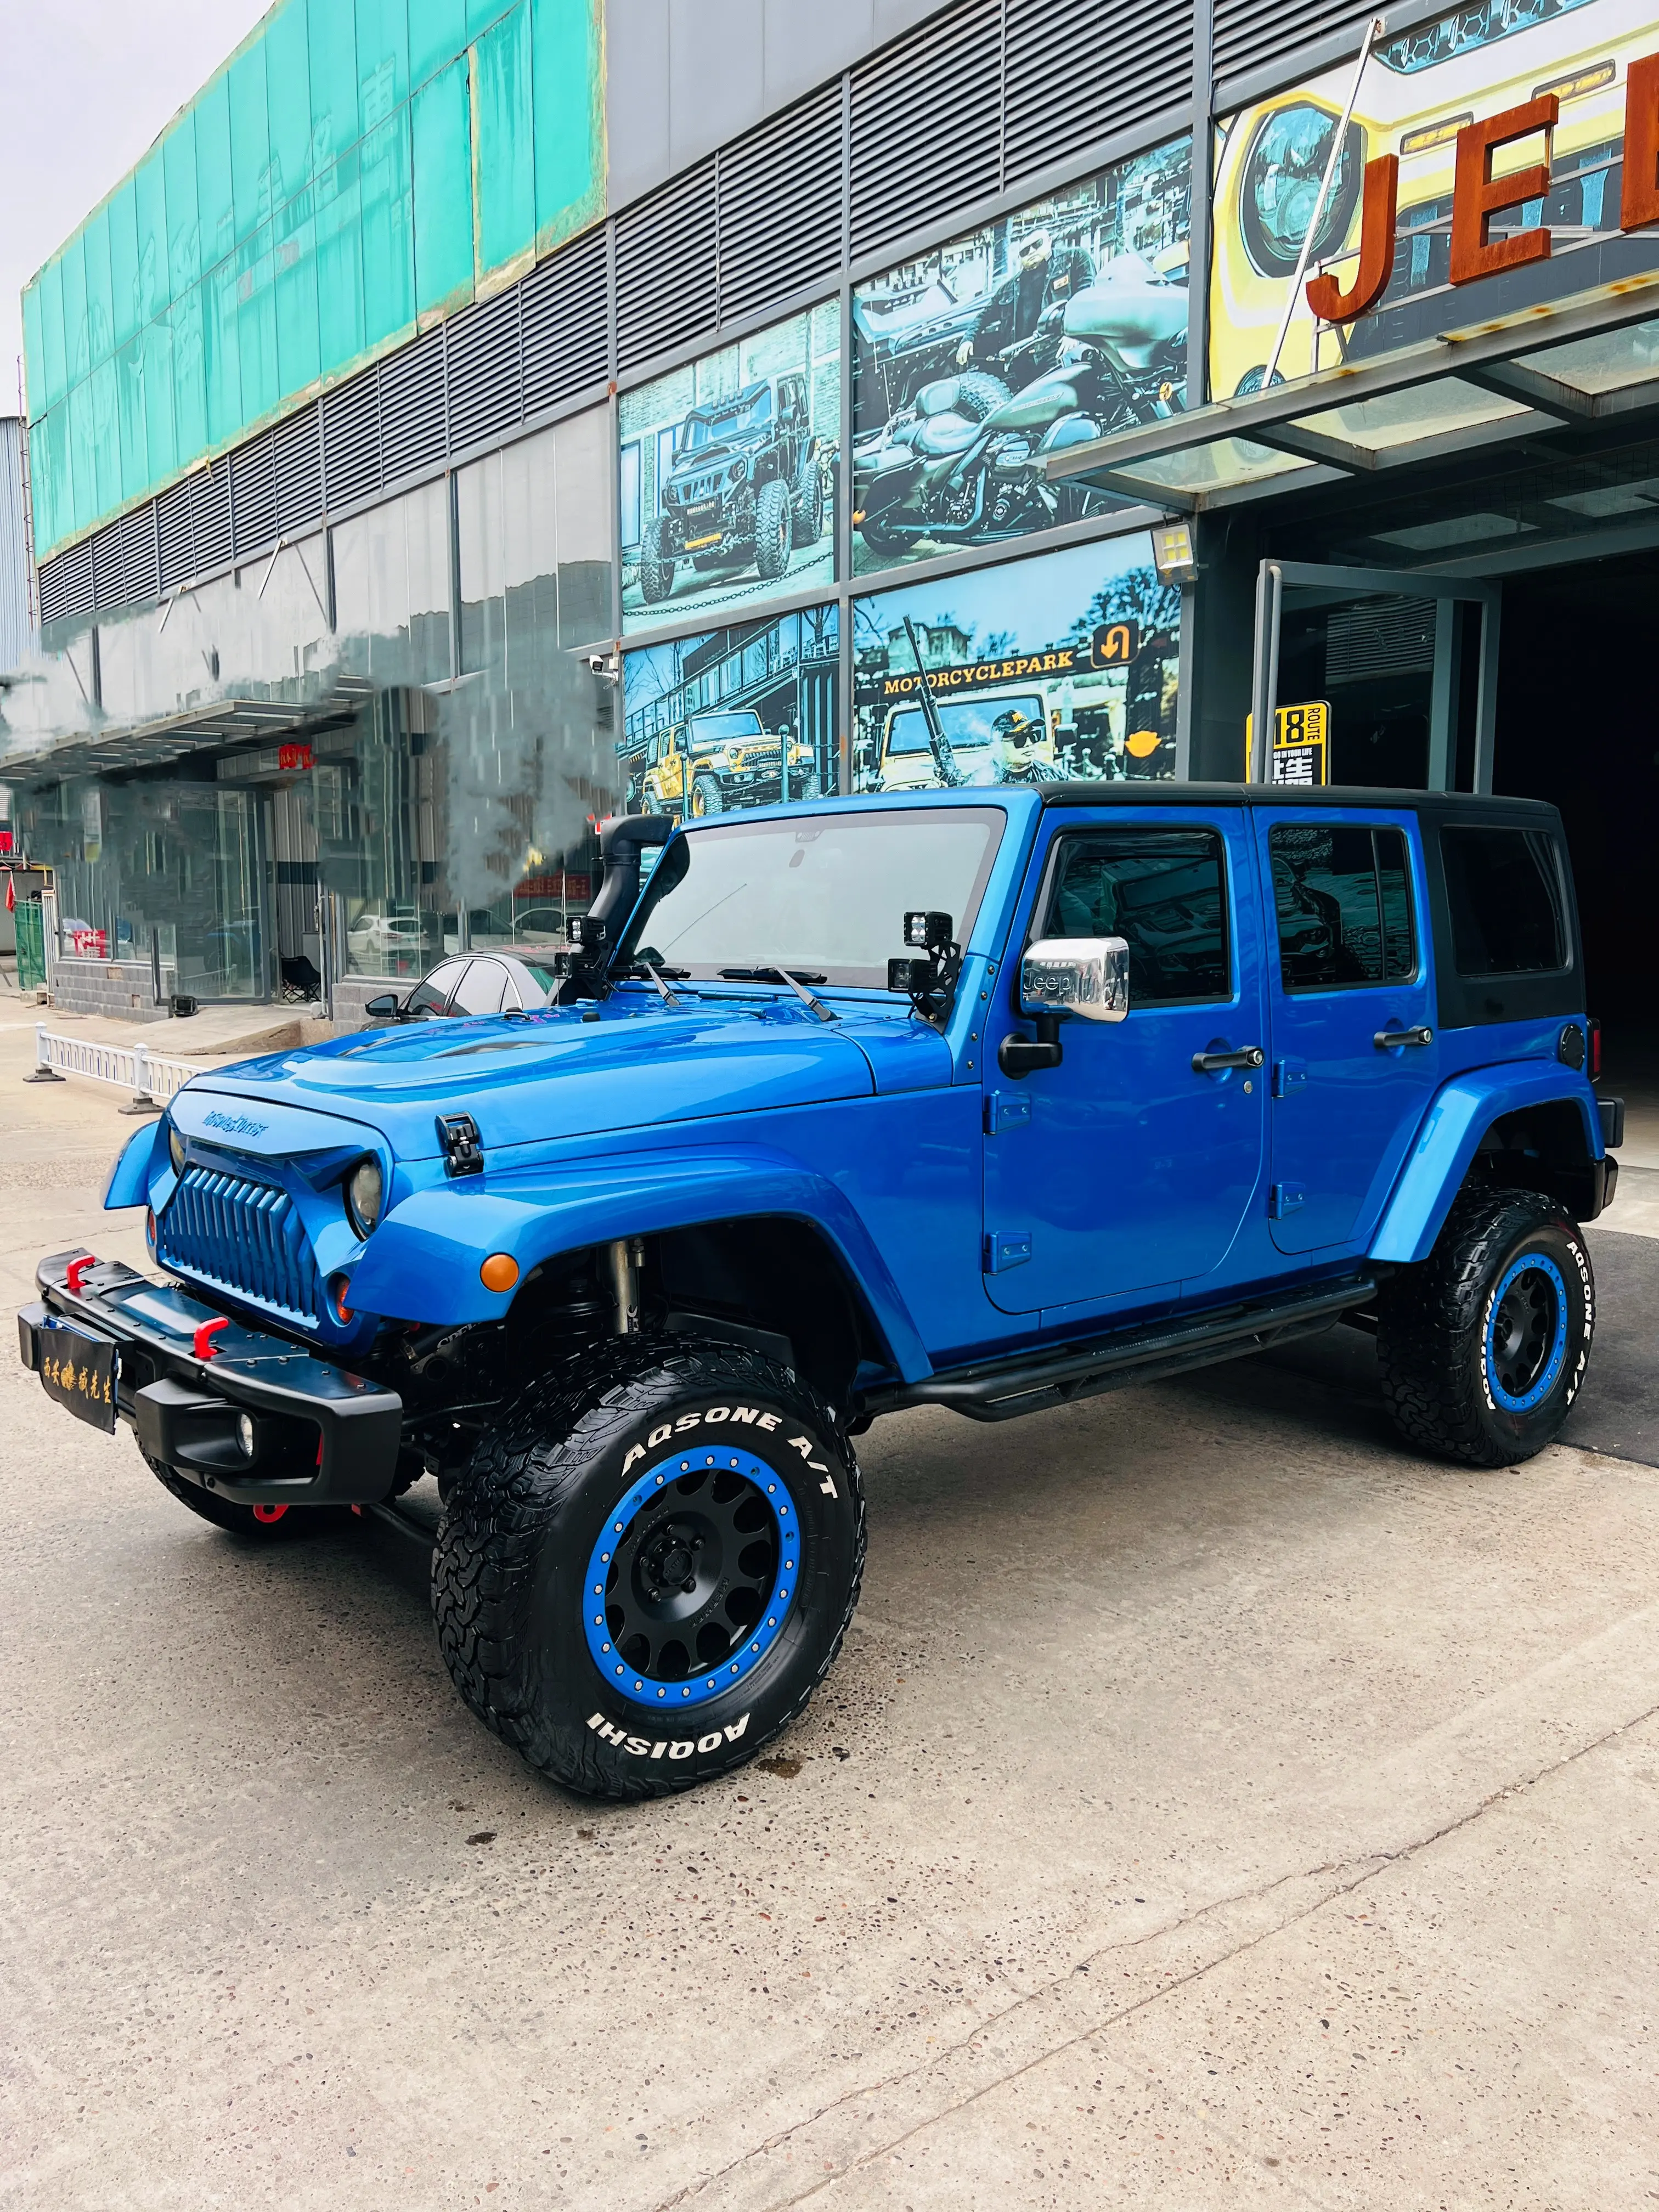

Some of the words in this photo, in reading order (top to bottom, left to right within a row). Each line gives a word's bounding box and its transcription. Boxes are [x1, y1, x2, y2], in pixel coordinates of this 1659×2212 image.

[884, 651, 1074, 695] MOTORCYCLEPARK
[1307, 707, 1321, 741] ROUTE
[1281, 750, 1287, 758] IN
[1288, 748, 1301, 758] YOUR
[1301, 747, 1313, 756] LIFE
[1024, 972, 1071, 994] Jeep
[1566, 1241, 1592, 1340] AQSONE
[1567, 1350, 1585, 1406] A/T
[621, 1406, 783, 1477] AQSONE
[786, 1435, 838, 1499] A/T
[585, 1712, 751, 1760] AOQISHI
